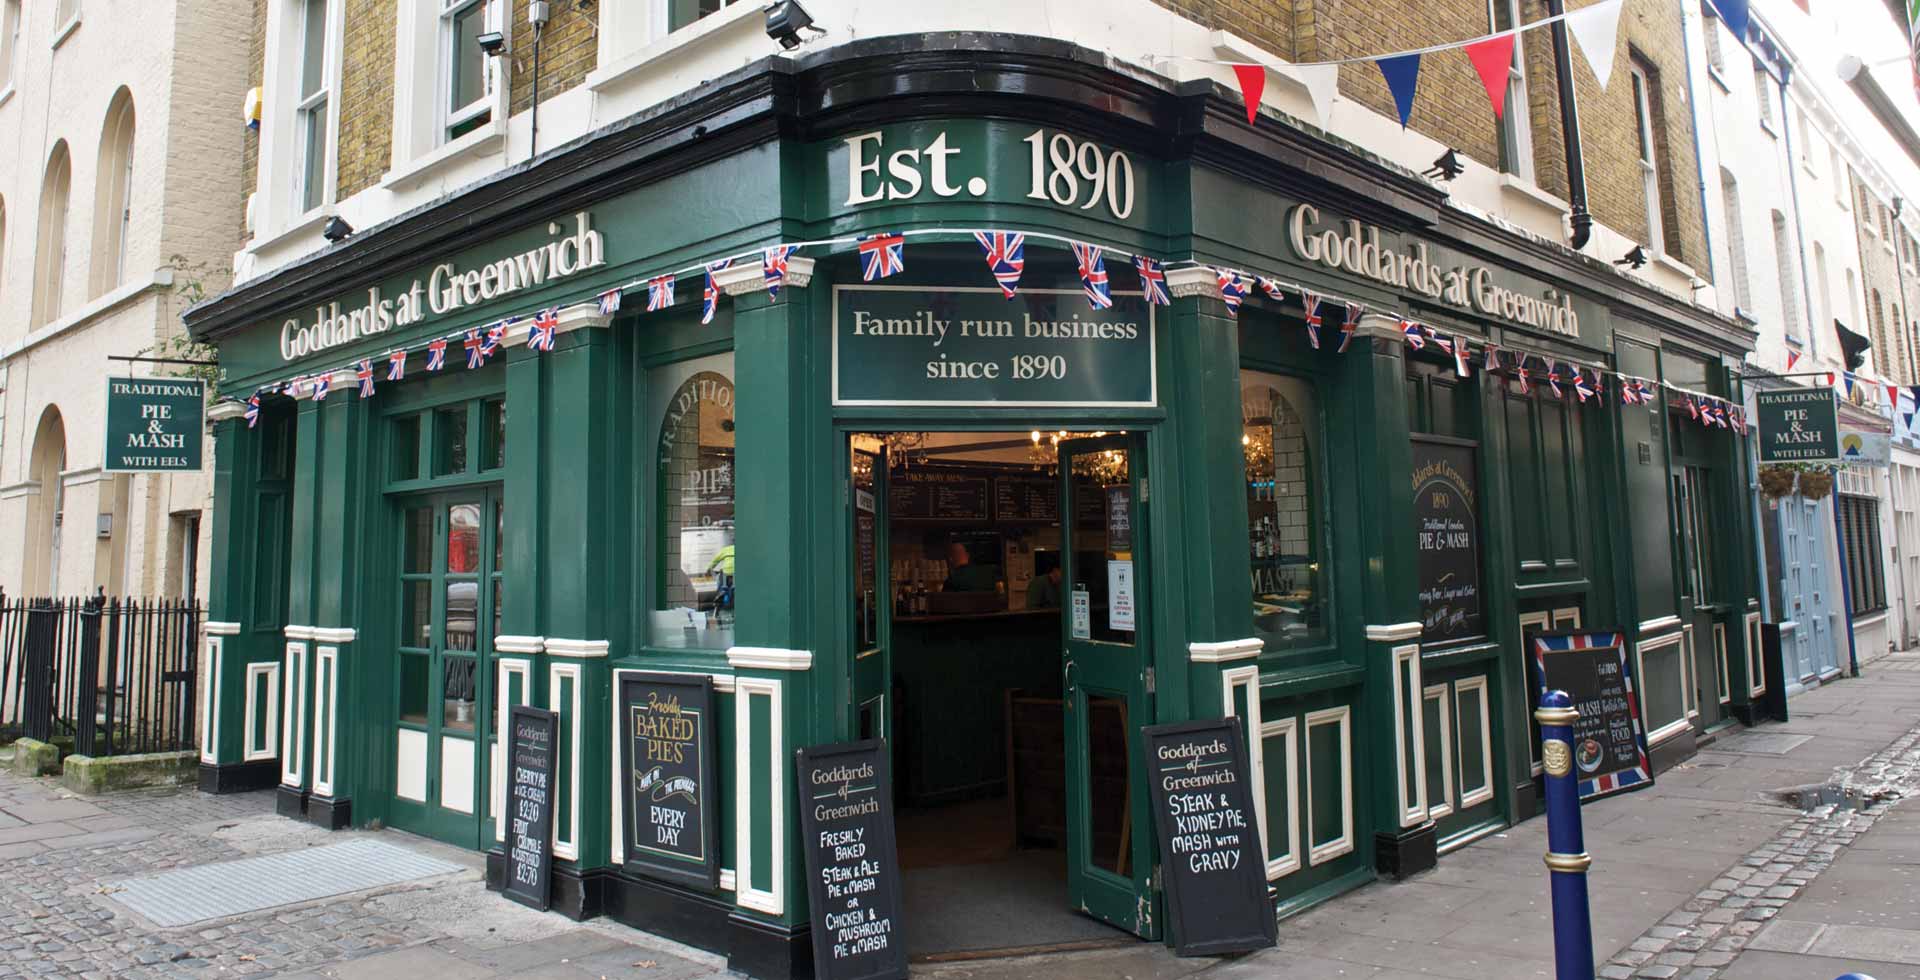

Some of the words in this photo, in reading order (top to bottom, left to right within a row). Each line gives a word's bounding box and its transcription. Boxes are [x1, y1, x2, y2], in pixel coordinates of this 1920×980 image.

[844, 131, 987, 207] Est.
[1024, 129, 1134, 219] 1890
[1288, 203, 1442, 298] Goddards
[1442, 266, 1471, 307] at
[1471, 267, 1579, 338] Greenwich
[280, 287, 393, 361] Goddards
[396, 279, 425, 324] at
[429, 211, 606, 314] Greenwich
[853, 311, 951, 346] Family
[960, 318, 1013, 337] run
[1024, 313, 1137, 339] business
[926, 353, 999, 378] since
[1011, 355, 1066, 379] 1890
[112, 383, 200, 396] TRADITIONAL
[1759, 392, 1831, 404] TRADITIONAL
[141, 404, 172, 419] PIE
[1784, 409, 1808, 421] PIE
[148, 420, 163, 433] &
[1790, 422, 1803, 432] &
[127, 433, 185, 448] MASH
[1776, 431, 1822, 444] MASH
[122, 456, 157, 466] WITH
[161, 457, 188, 466] EELS
[1773, 450, 1802, 458] WITH
[1804, 449, 1826, 457] EELS
[689, 468, 722, 495] PIE
[1419, 532, 1433, 550] PIE
[1436, 531, 1445, 550] &
[1446, 532, 1468, 549] MASH
[648, 691, 682, 722] Freshly
[1579, 701, 1601, 717] MASH
[637, 714, 693, 740] BAKED
[647, 740, 683, 764] PIES
[1158, 739, 1227, 760] Goddards
[516, 767, 538, 786] CHERRY
[812, 763, 874, 785] Goddards
[1163, 769, 1236, 791] Greenwich
[815, 797, 879, 822] Greenwich
[1168, 794, 1215, 816] STEAK
[1221, 794, 1229, 807] &
[650, 806, 686, 828] EVERY
[1176, 813, 1224, 835] KIDNEY
[1226, 809, 1247, 829] PIE,
[657, 826, 680, 846] DAY
[820, 828, 864, 848] FRESHLY
[1172, 835, 1212, 854] MASH
[1216, 835, 1239, 847] WITH
[835, 843, 866, 862] BAKED
[1190, 849, 1240, 873] GRAVY
[822, 867, 853, 884] STEAK
[854, 866, 860, 877] &
[861, 860, 880, 876] ALE
[828, 883, 842, 899] PIE
[844, 886, 849, 894] &
[849, 878, 875, 894] MASH
[847, 897, 859, 909] OR
[825, 910, 864, 931] CHICKEN
[869, 908, 876, 920] &
[838, 918, 891, 943] MUSHROOM
[834, 944, 848, 959] PIE
[851, 944, 857, 954] &
[857, 934, 888, 953] MASH
